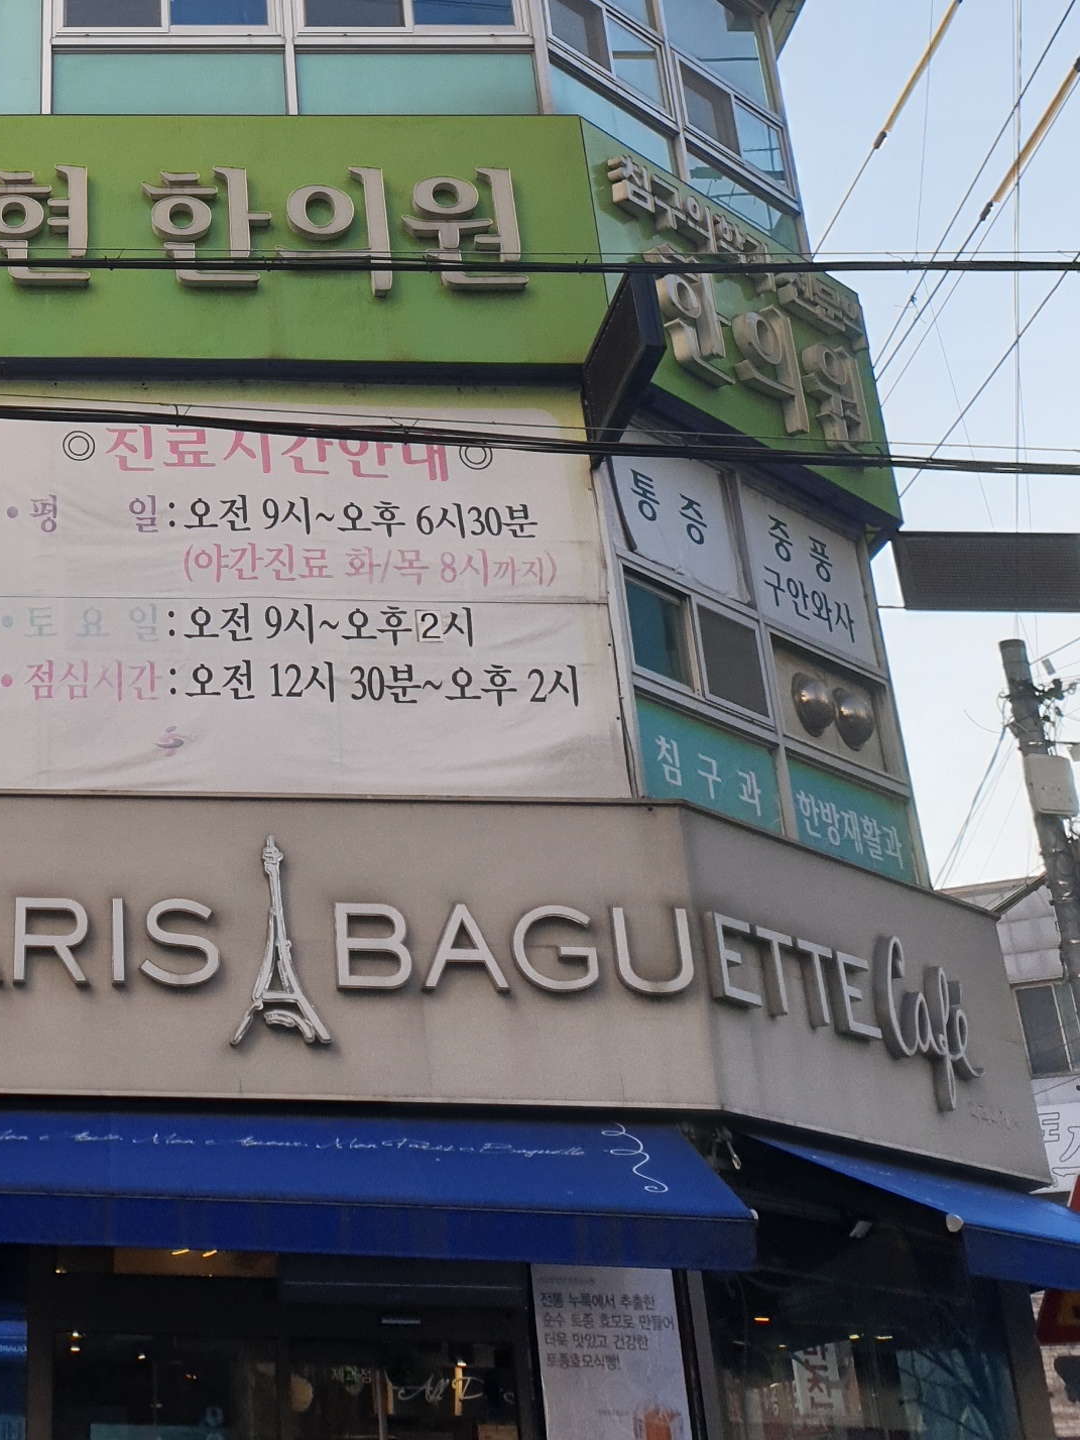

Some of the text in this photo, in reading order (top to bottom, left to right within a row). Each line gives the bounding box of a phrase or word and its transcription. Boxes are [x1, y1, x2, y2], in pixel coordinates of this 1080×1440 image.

[140, 164, 529, 298] 한의원
[105, 424, 450, 482] 진료시간안내
[415, 502, 539, 540] 6시30분
[183, 541, 558, 588] (야간진료 화/목 8시까지)
[763, 565, 856, 644] 구안와사
[269, 660, 335, 703] 12시
[527, 664, 580, 708] 2시
[795, 789, 903, 870] 한방재활과
